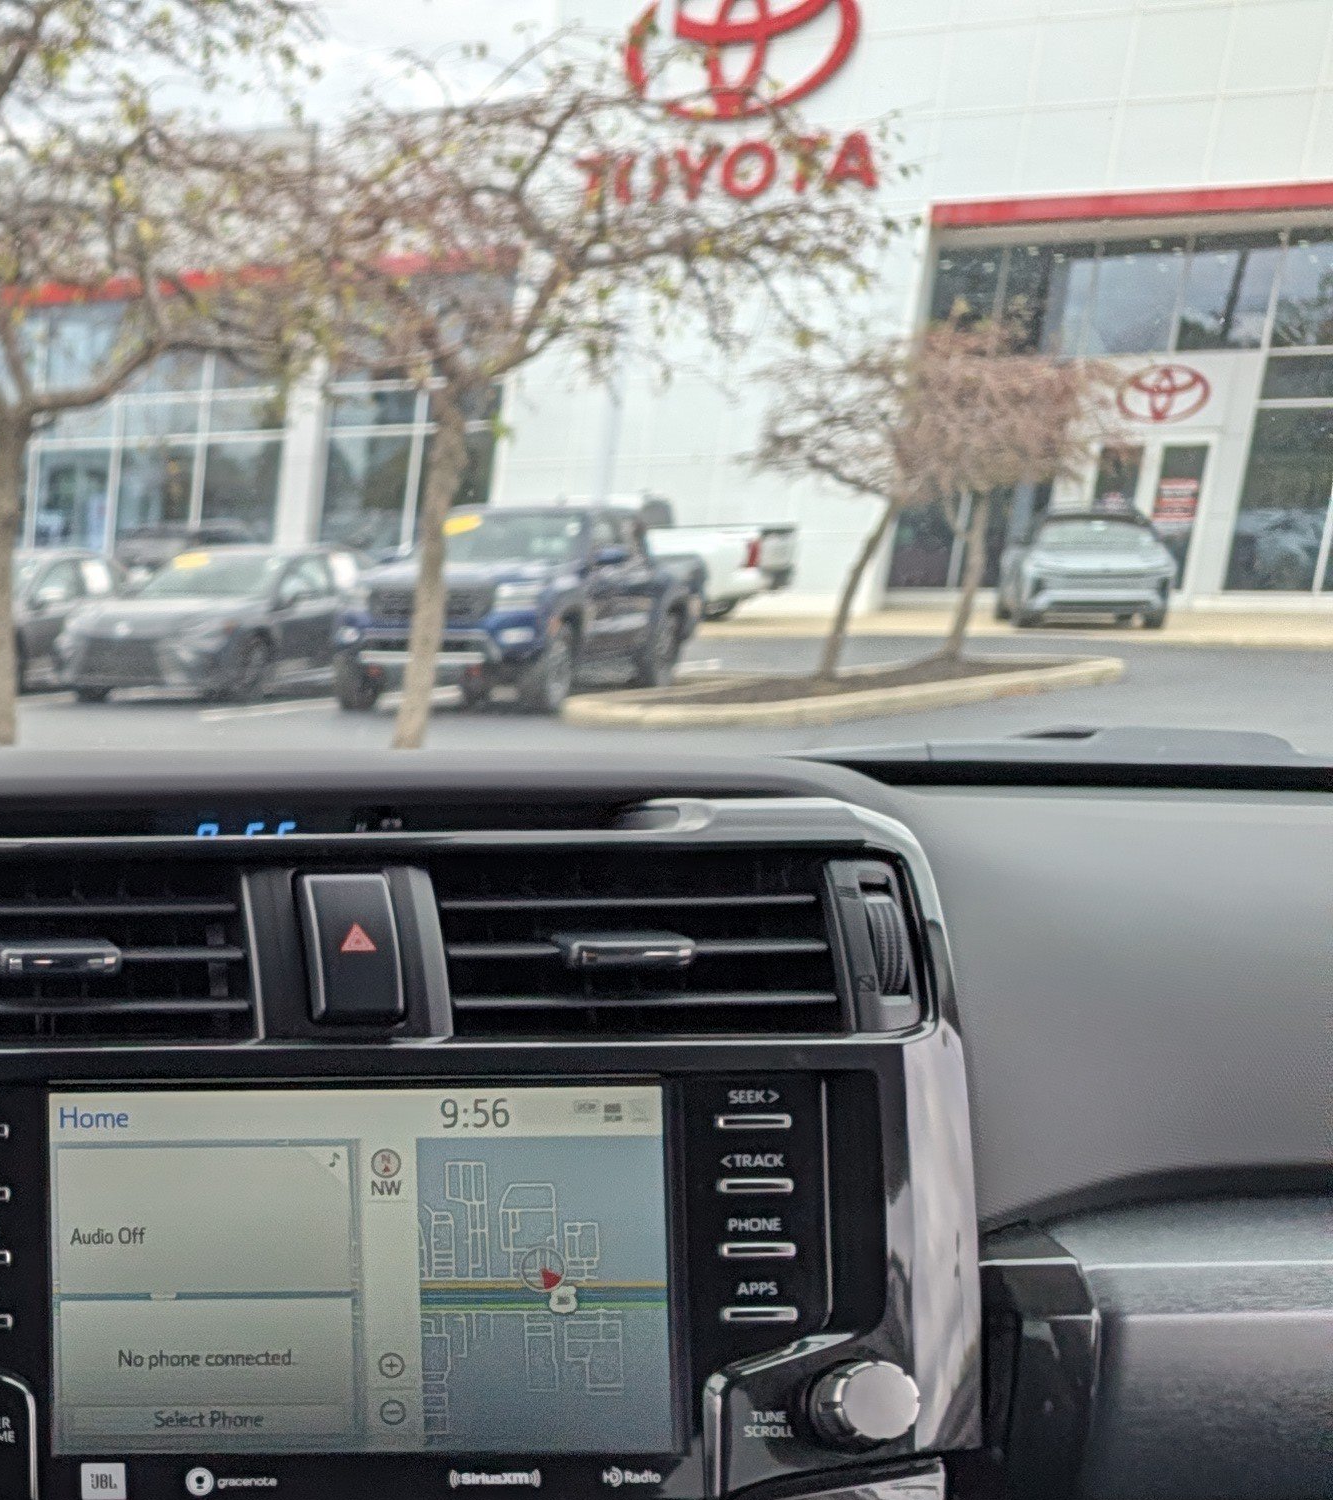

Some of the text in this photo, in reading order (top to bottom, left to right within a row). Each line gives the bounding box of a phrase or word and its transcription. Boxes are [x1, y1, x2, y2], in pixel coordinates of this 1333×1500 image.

[573, 130, 879, 207] TOYOTA
[59, 1098, 510, 1129] Home 9:56
[371, 1180, 402, 1196] NW
[727, 1217, 782, 1232] PHONE
[70, 1227, 146, 1245] Audio Off
[737, 1281, 778, 1296] APPS
[118, 1350, 144, 1368] No
[148, 1350, 200, 1370] phone
[154, 1410, 264, 1428] Select Phone
[750, 1410, 787, 1423] TUNE
[743, 1425, 794, 1438] SCROLL
[90, 1473, 118, 1489] JBL
[217, 1475, 277, 1489] gracenote
[624, 1469, 661, 1484] Radio
